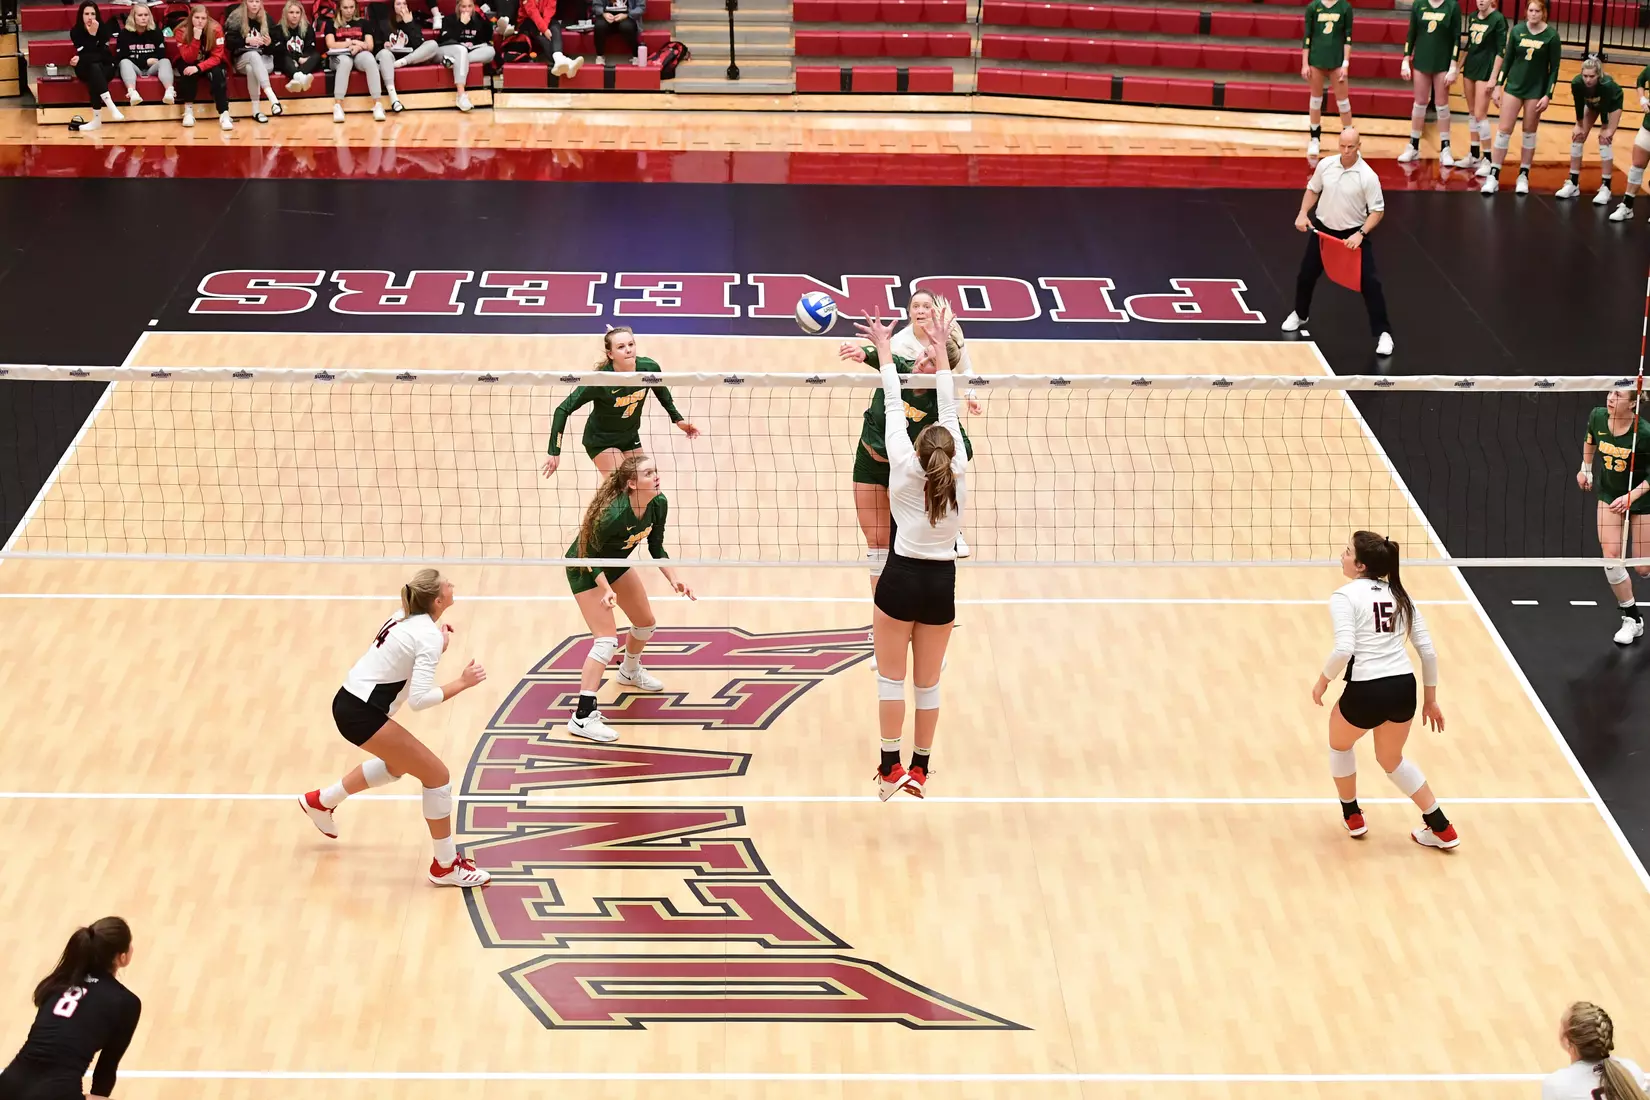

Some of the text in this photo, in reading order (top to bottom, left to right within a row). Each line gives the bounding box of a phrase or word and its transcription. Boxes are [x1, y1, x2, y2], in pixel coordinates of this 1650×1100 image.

[188, 269, 1267, 323] PIONEERS
[1603, 455, 1628, 472] 13
[1373, 602, 1395, 633] 15
[456, 624, 1035, 1031] DENVER
